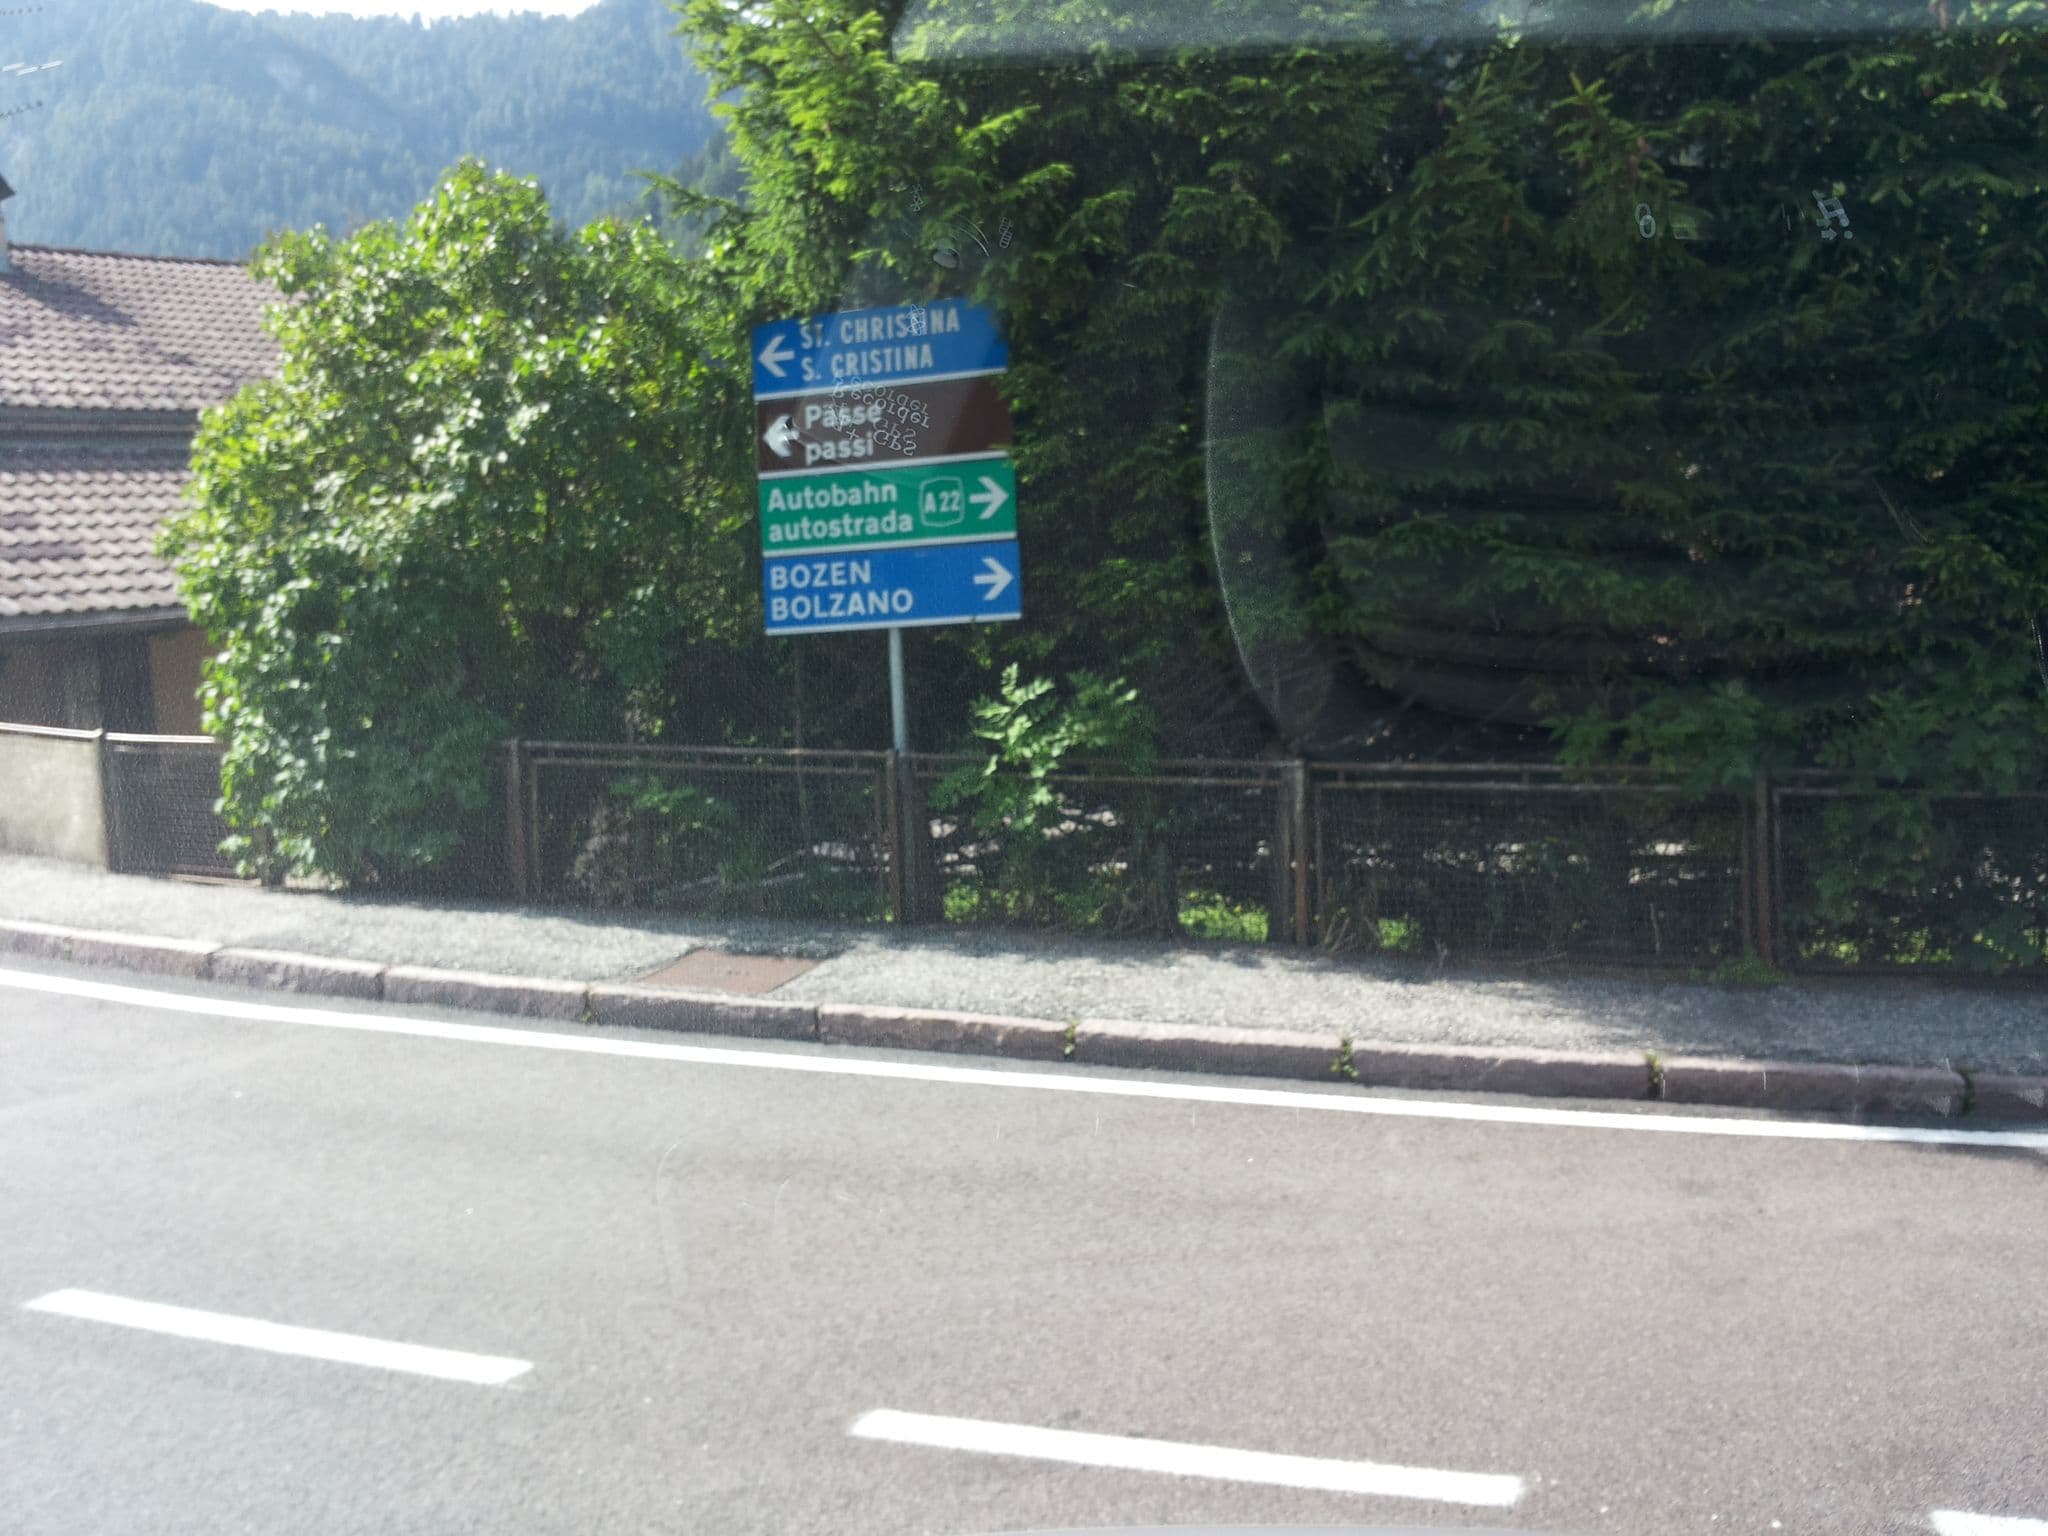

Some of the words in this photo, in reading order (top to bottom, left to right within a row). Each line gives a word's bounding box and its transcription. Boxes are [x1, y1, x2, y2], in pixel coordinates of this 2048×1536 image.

[800, 322, 832, 350] ST.
[801, 356, 822, 382] S.
[831, 344, 934, 378] CRISTINA
[806, 431, 874, 466] passi
[767, 480, 898, 513] Autobahn
[769, 509, 914, 543] autostrada
[770, 559, 871, 590] BOZEN
[771, 588, 914, 622] BOLZANO
